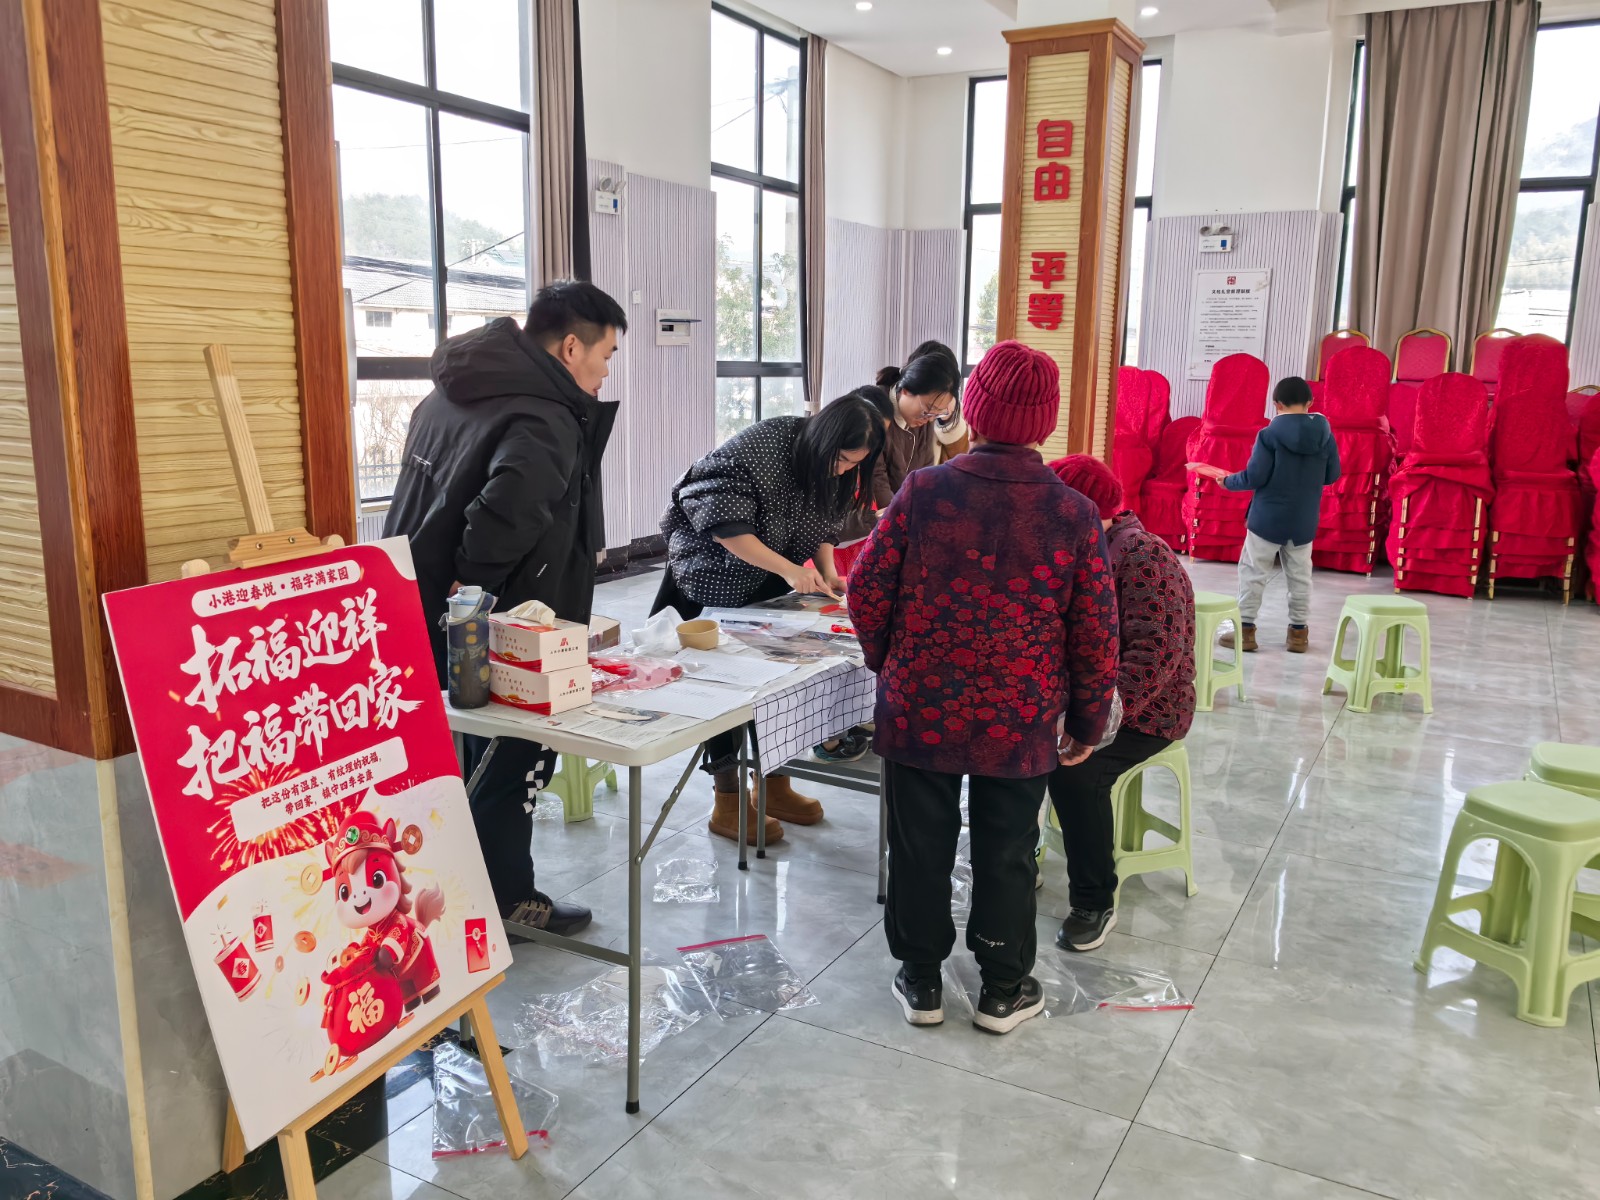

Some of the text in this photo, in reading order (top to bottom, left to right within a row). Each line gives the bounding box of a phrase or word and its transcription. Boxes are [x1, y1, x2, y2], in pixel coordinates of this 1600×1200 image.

[1034, 119, 1073, 201] 自由
[1027, 252, 1067, 331] 平等
[208, 566, 350, 609] 小港迎春悦·福字满家园
[180, 588, 388, 714] 拓福迎祥
[177, 664, 425, 800] 把福带回家
[347, 981, 384, 1034] 福
